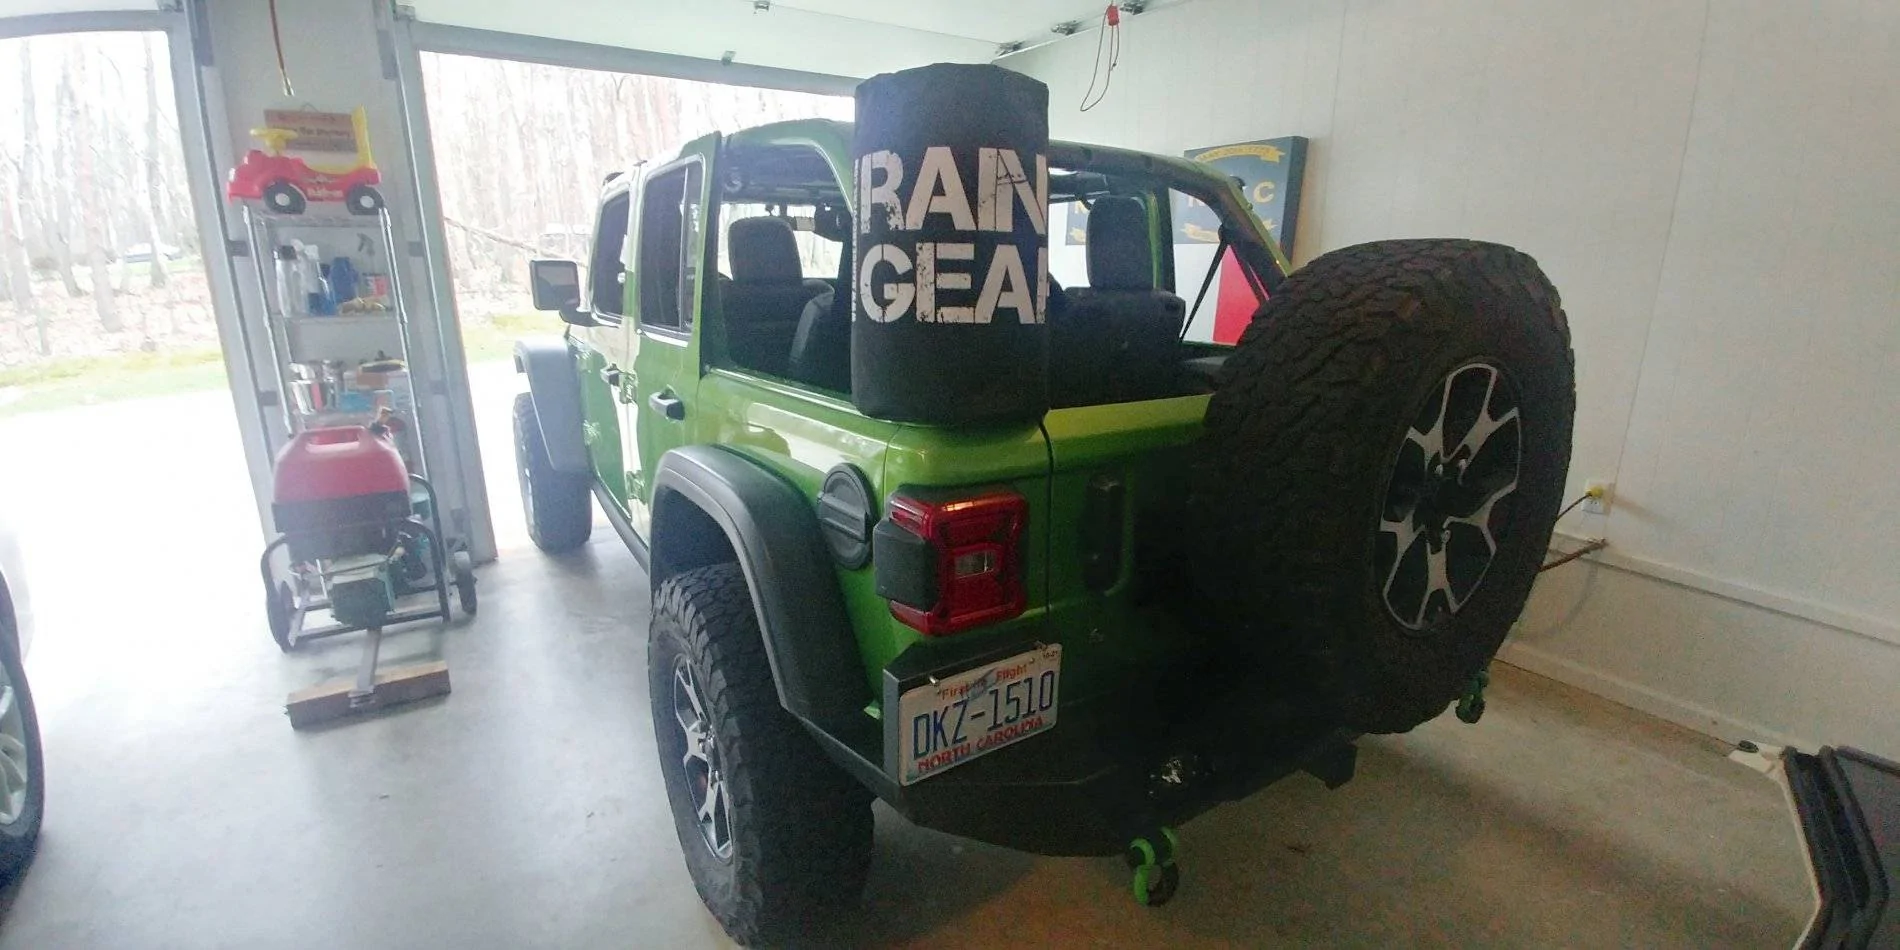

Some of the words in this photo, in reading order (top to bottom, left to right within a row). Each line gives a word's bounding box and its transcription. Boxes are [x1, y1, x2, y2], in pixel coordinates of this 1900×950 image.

[860, 146, 1049, 235] RAIN
[1253, 181, 1276, 203] C
[859, 242, 1049, 324] GEA
[913, 670, 1056, 761] DKZ-1510
[917, 743, 972, 773] NORTH
[976, 715, 1044, 748] CAROLINA
